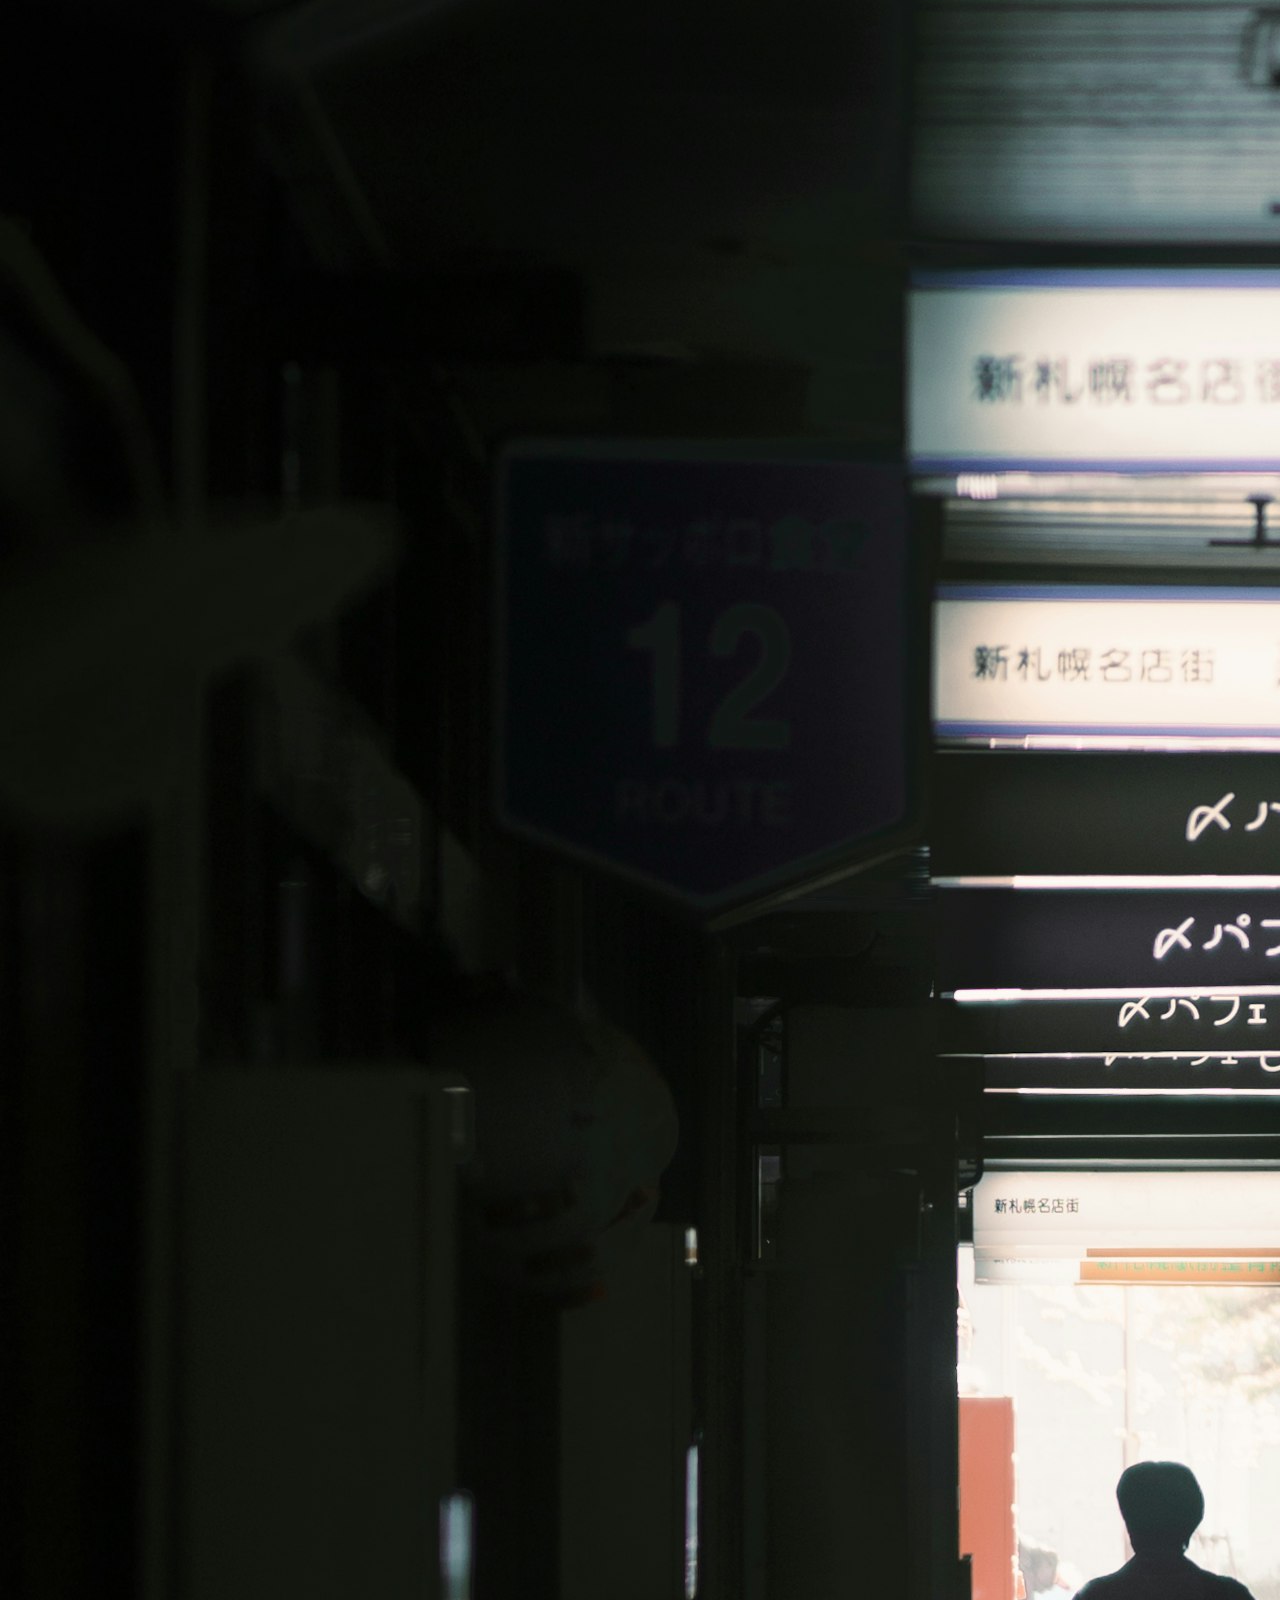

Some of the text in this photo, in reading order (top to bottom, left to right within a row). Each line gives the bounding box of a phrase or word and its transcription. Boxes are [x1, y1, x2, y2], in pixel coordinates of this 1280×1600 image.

[627, 600, 792, 749] 12
[972, 643, 1216, 684] 新札幌名店街
[993, 1197, 1080, 1215] 新札幌名店街
